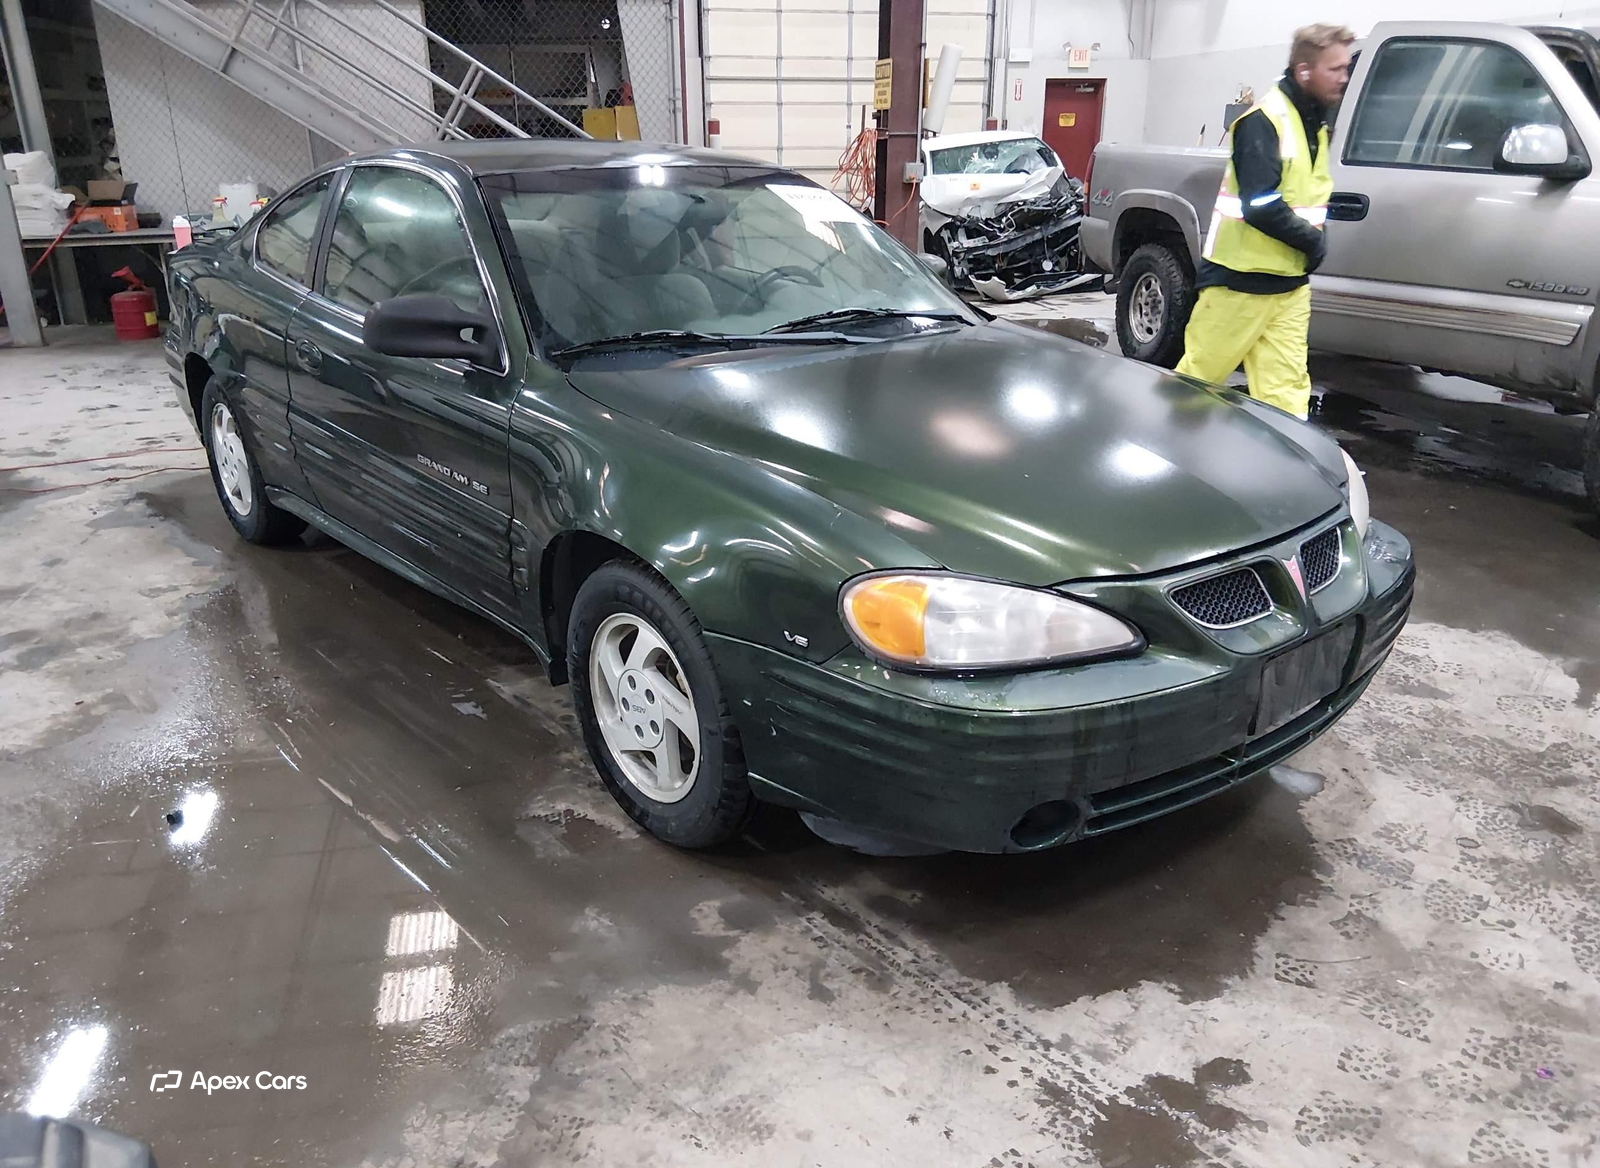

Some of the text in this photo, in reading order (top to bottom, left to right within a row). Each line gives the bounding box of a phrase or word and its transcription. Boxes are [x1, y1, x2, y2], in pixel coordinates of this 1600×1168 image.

[1074, 50, 1088, 61] EXIT
[1528, 281, 1567, 294] 1500
[417, 453, 489, 496] GRAND AM SE
[783, 630, 809, 648] V6
[632, 704, 646, 714] ABS
